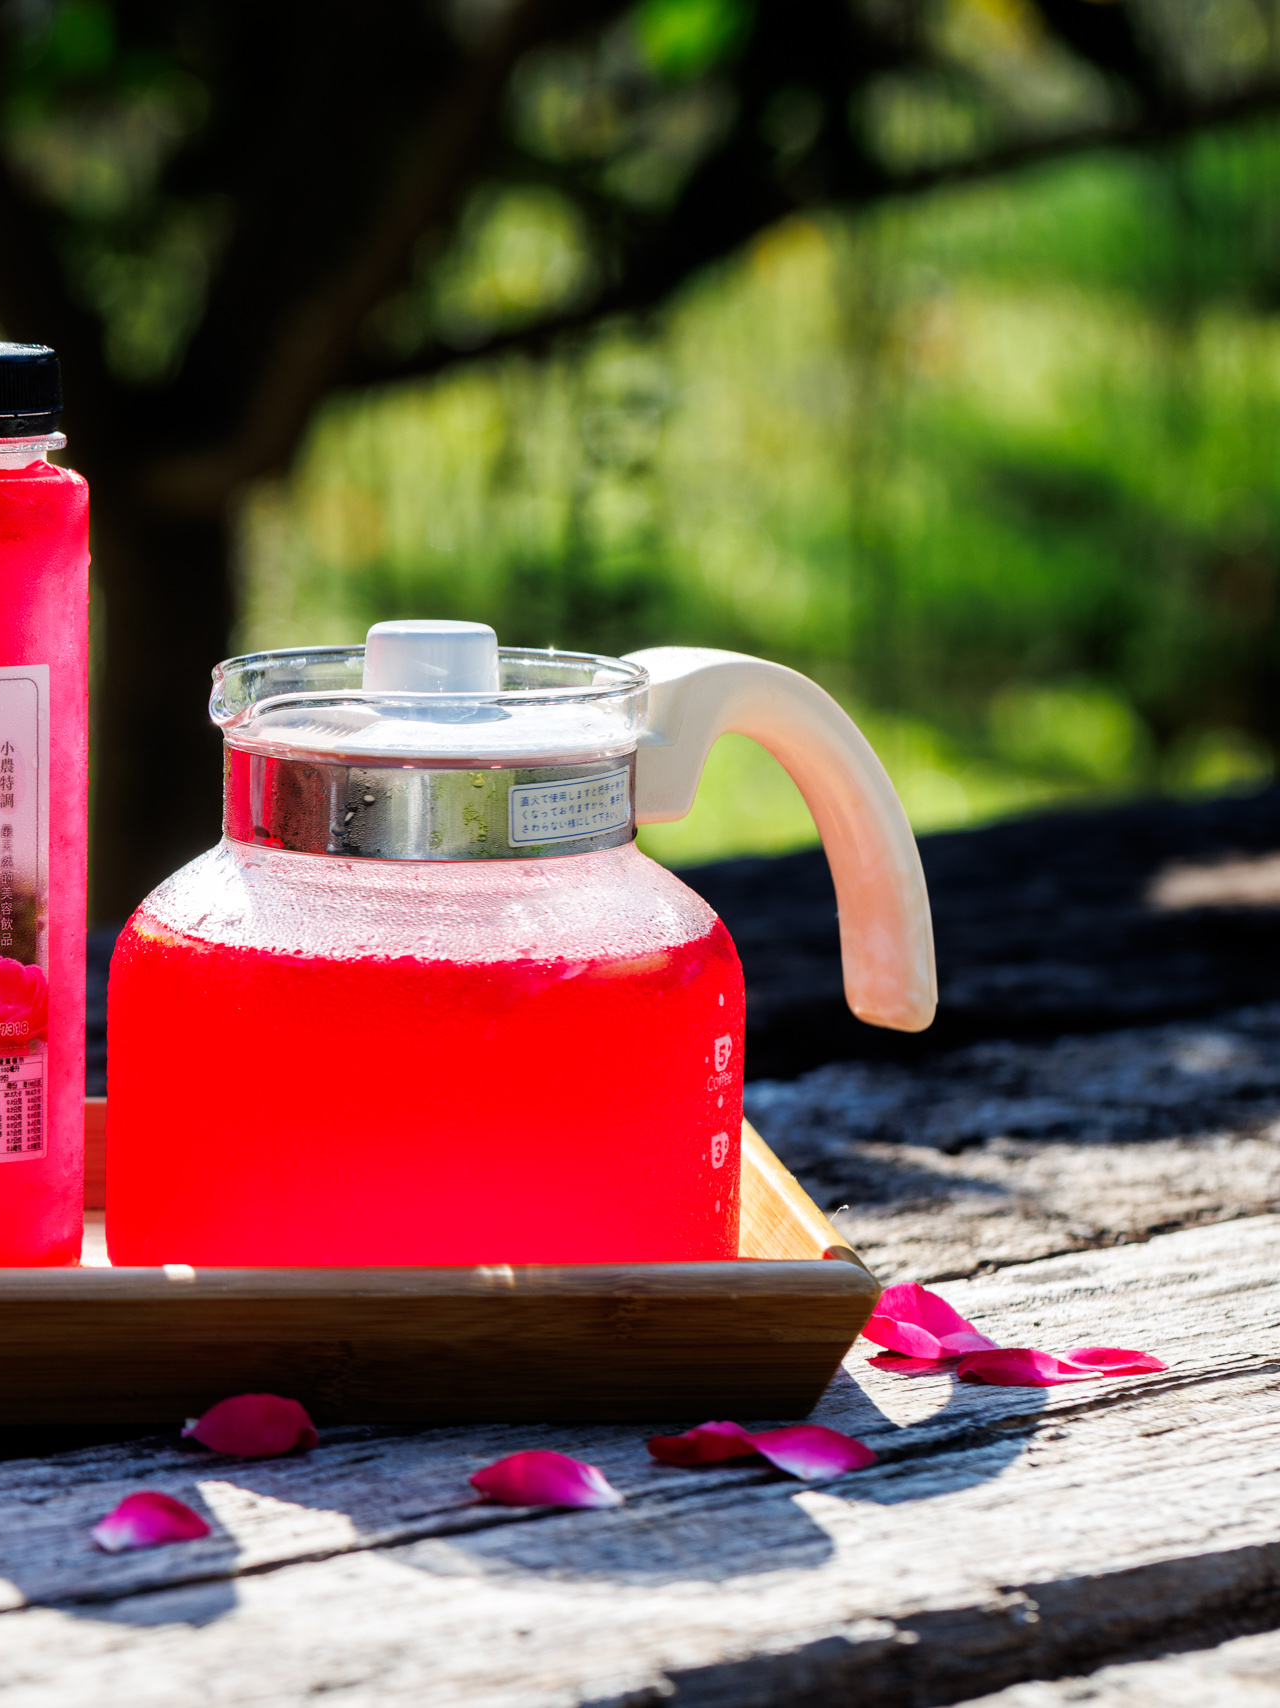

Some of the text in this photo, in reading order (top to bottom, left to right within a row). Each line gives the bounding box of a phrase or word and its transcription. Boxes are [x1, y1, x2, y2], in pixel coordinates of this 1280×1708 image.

[0, 741, 14, 808] 小農特調
[0, 824, 14, 946] 最天然的美容飲品
[706, 1072, 732, 1092] Coffee
